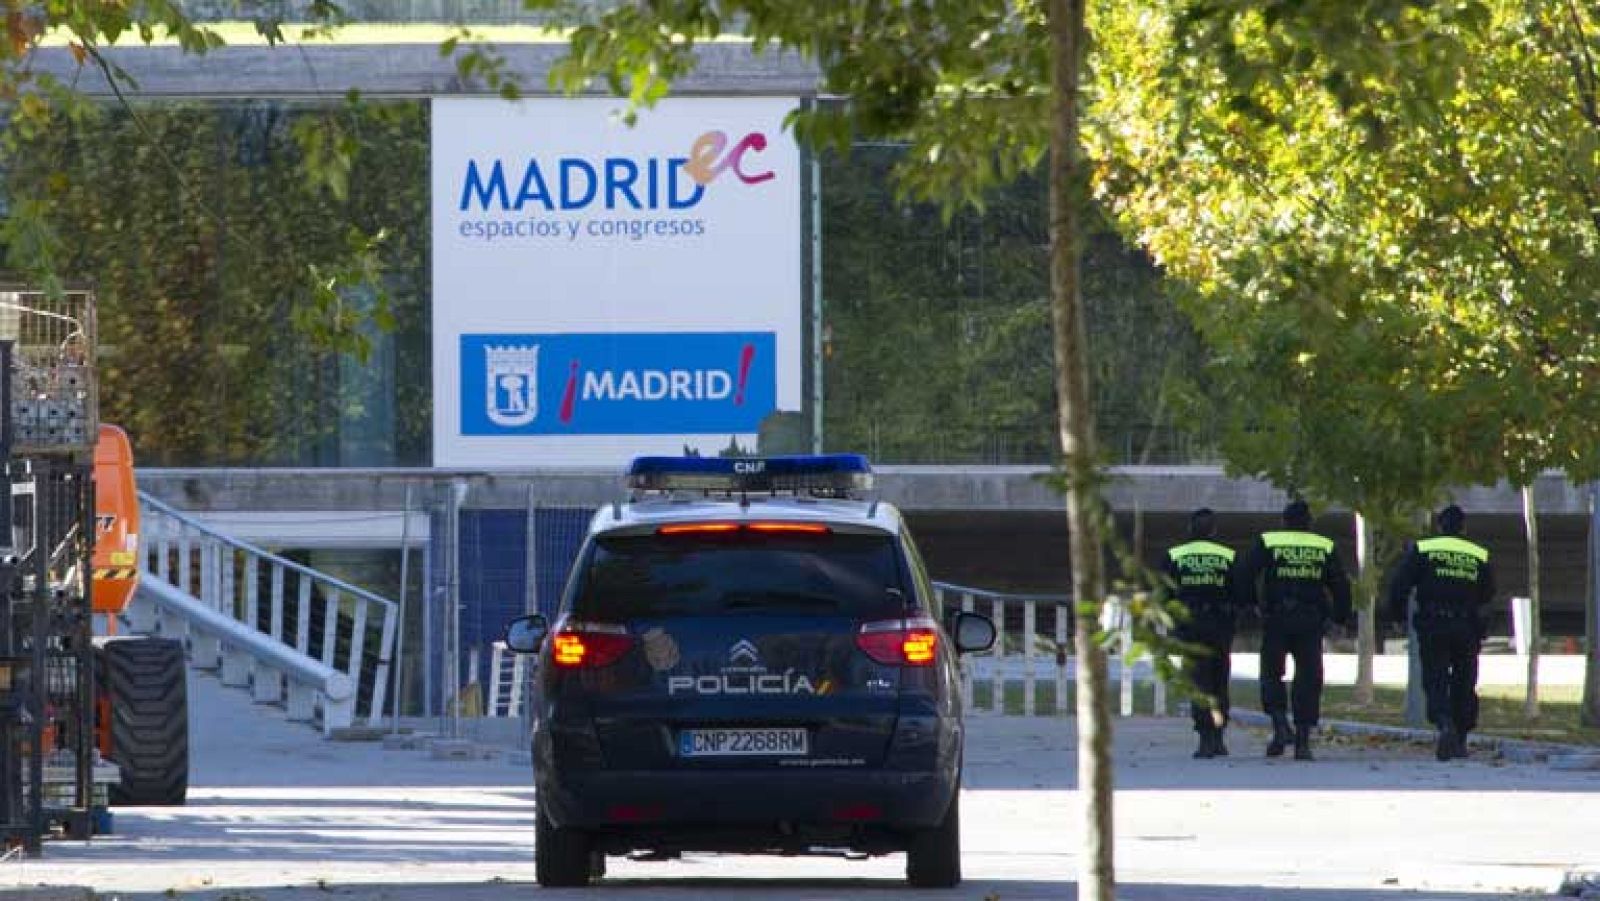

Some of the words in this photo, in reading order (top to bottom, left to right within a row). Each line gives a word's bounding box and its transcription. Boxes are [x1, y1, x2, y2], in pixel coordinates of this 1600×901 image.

[459, 157, 706, 211] MADRID
[682, 130, 776, 185] ec
[459, 217, 561, 240] espacios
[568, 221, 579, 240] y
[586, 218, 706, 241] congresos
[1177, 555, 1229, 571] POLICIA
[1273, 547, 1326, 563] POLICIA
[1180, 572, 1225, 587] madrid
[1277, 566, 1322, 581] madrid
[668, 667, 816, 696] POLICÍA
[693, 731, 804, 752] CNP2268RM
